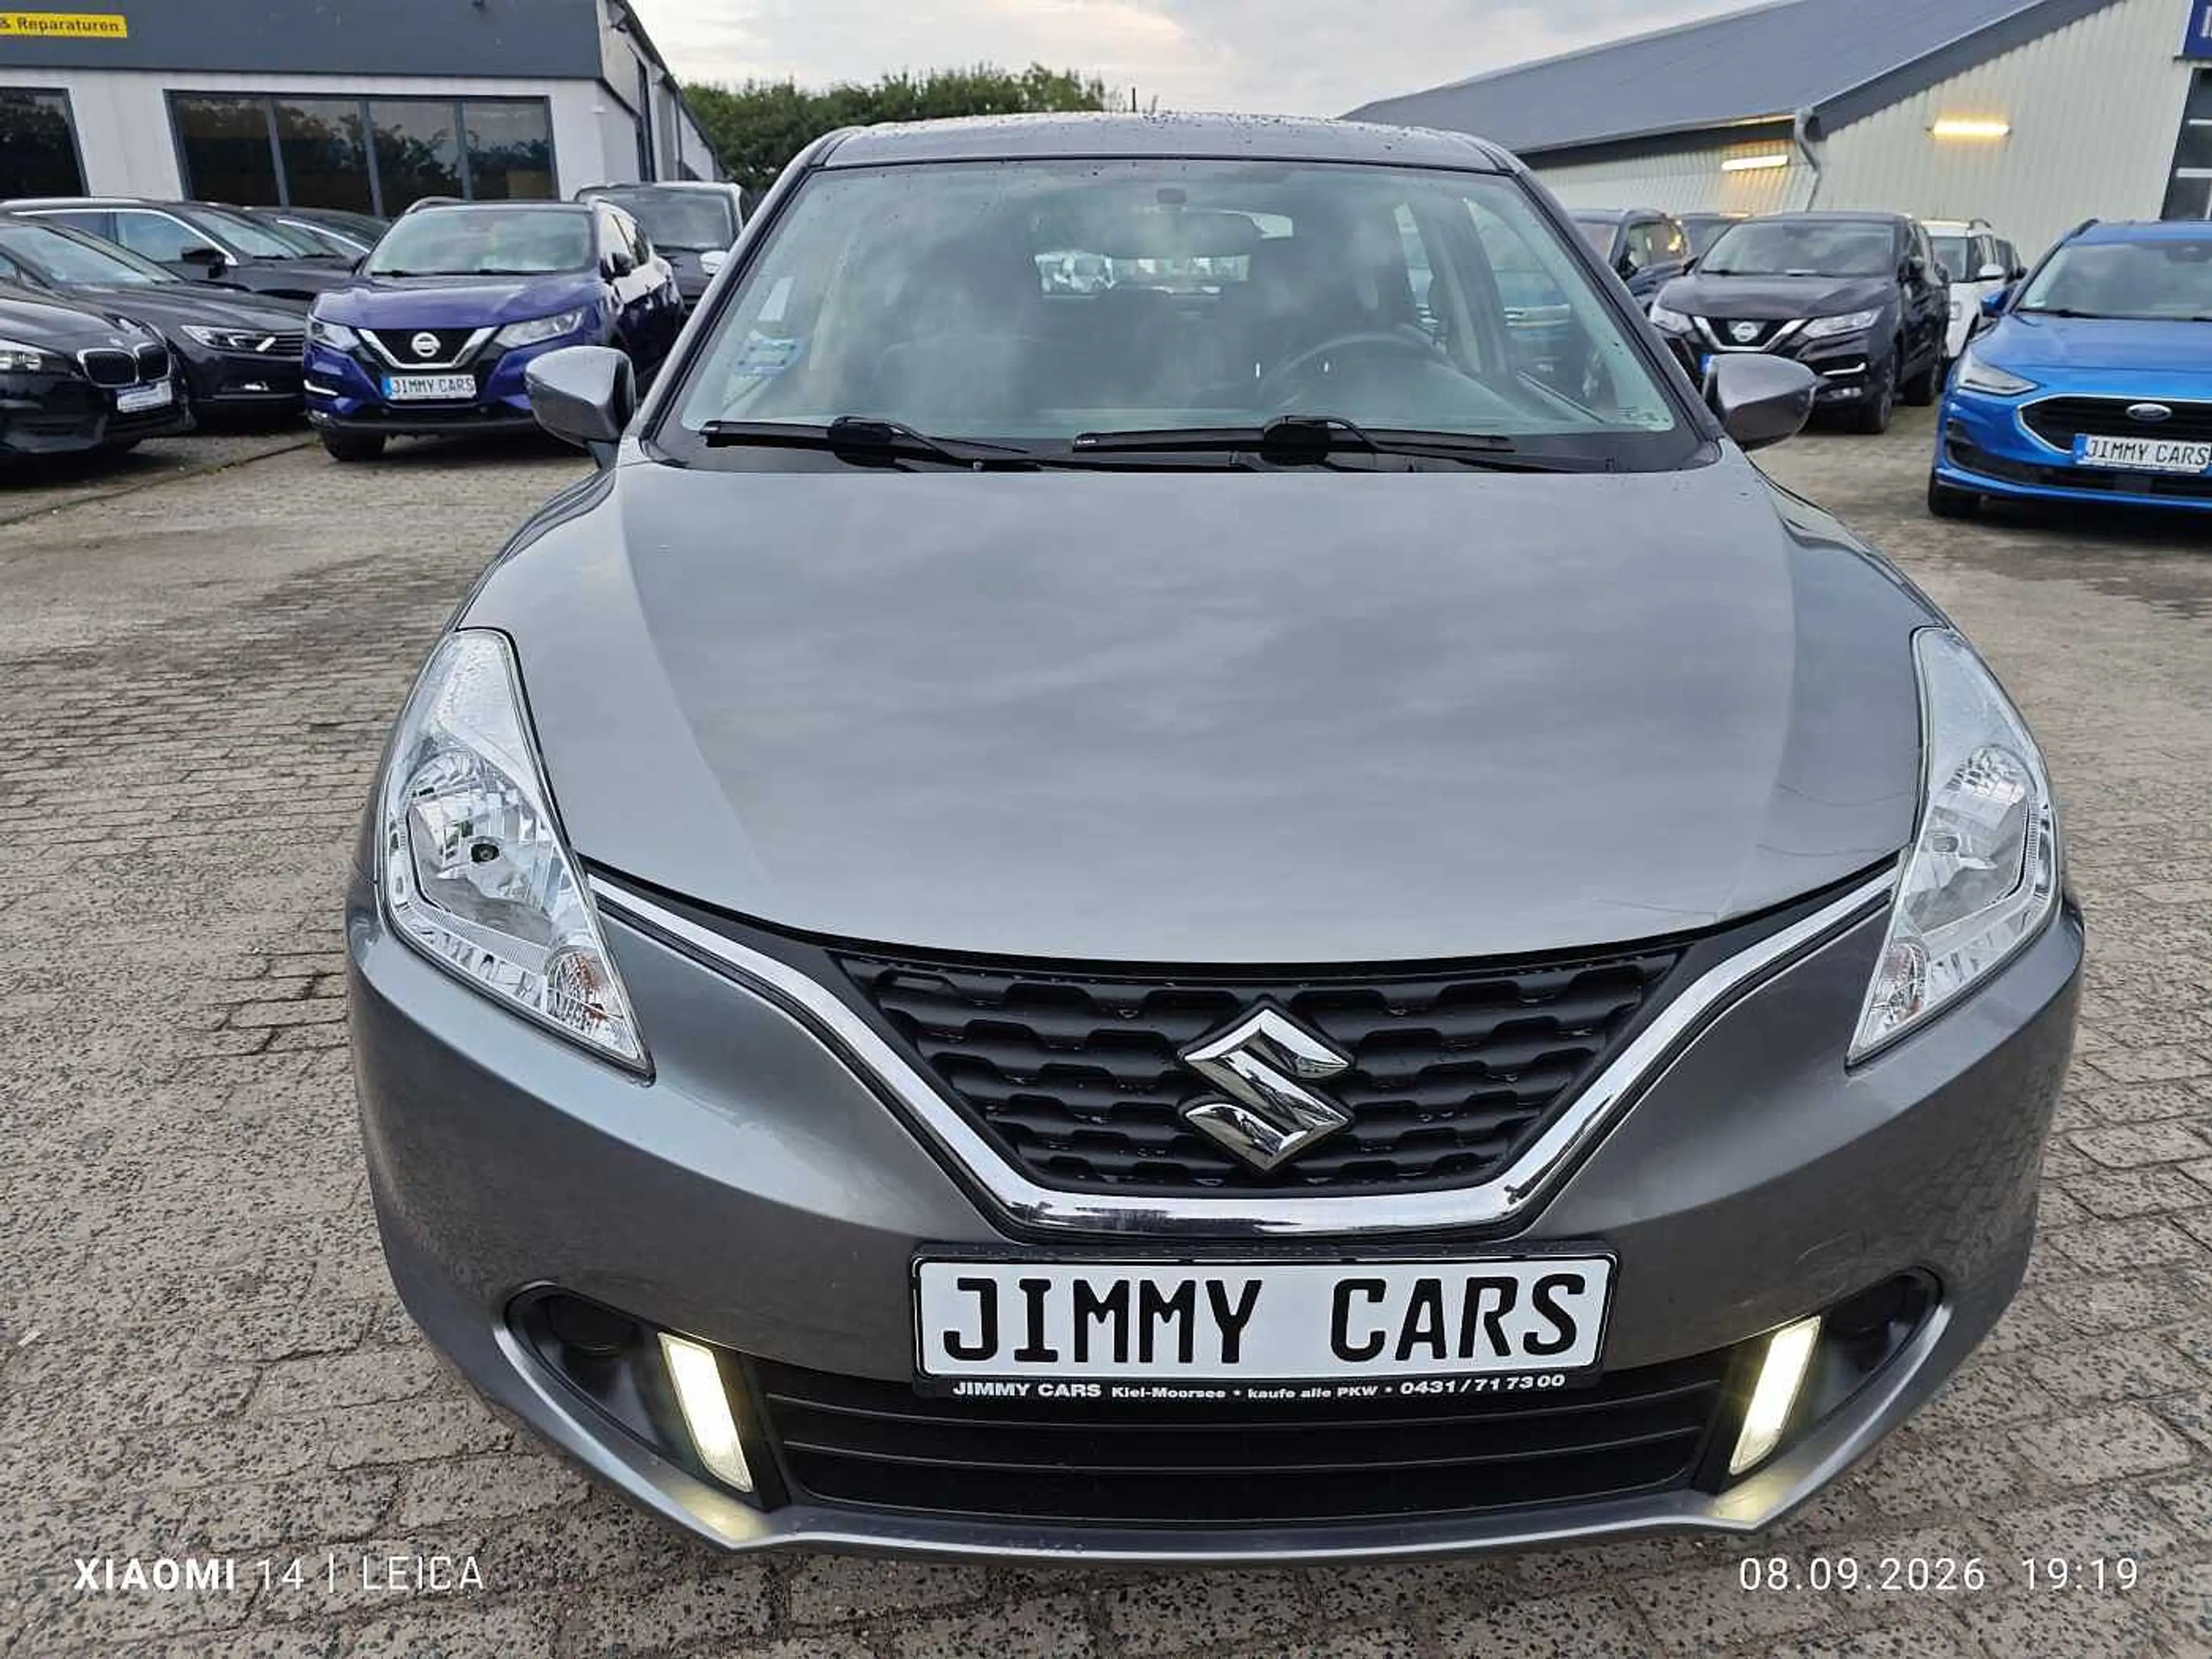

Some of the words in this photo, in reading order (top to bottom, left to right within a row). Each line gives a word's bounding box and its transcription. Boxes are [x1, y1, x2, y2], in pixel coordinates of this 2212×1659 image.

[17, 17, 120, 32] Reparaturen
[393, 379, 434, 393] JIMMY
[440, 378, 474, 392] CARS
[2085, 440, 2149, 461] JIMMY
[2156, 444, 2209, 465] CARS
[943, 1278, 1262, 1363] JIMMY
[1330, 1273, 1585, 1359] CARS
[952, 1382, 1031, 1396] JIMMY
[1037, 1383, 1103, 1397] CARS
[1111, 1387, 1226, 1398] Kiel-Moorsee
[1247, 1388, 1296, 1399] kaufe
[1300, 1388, 1332, 1398] alle
[1336, 1385, 1378, 1397] PKW
